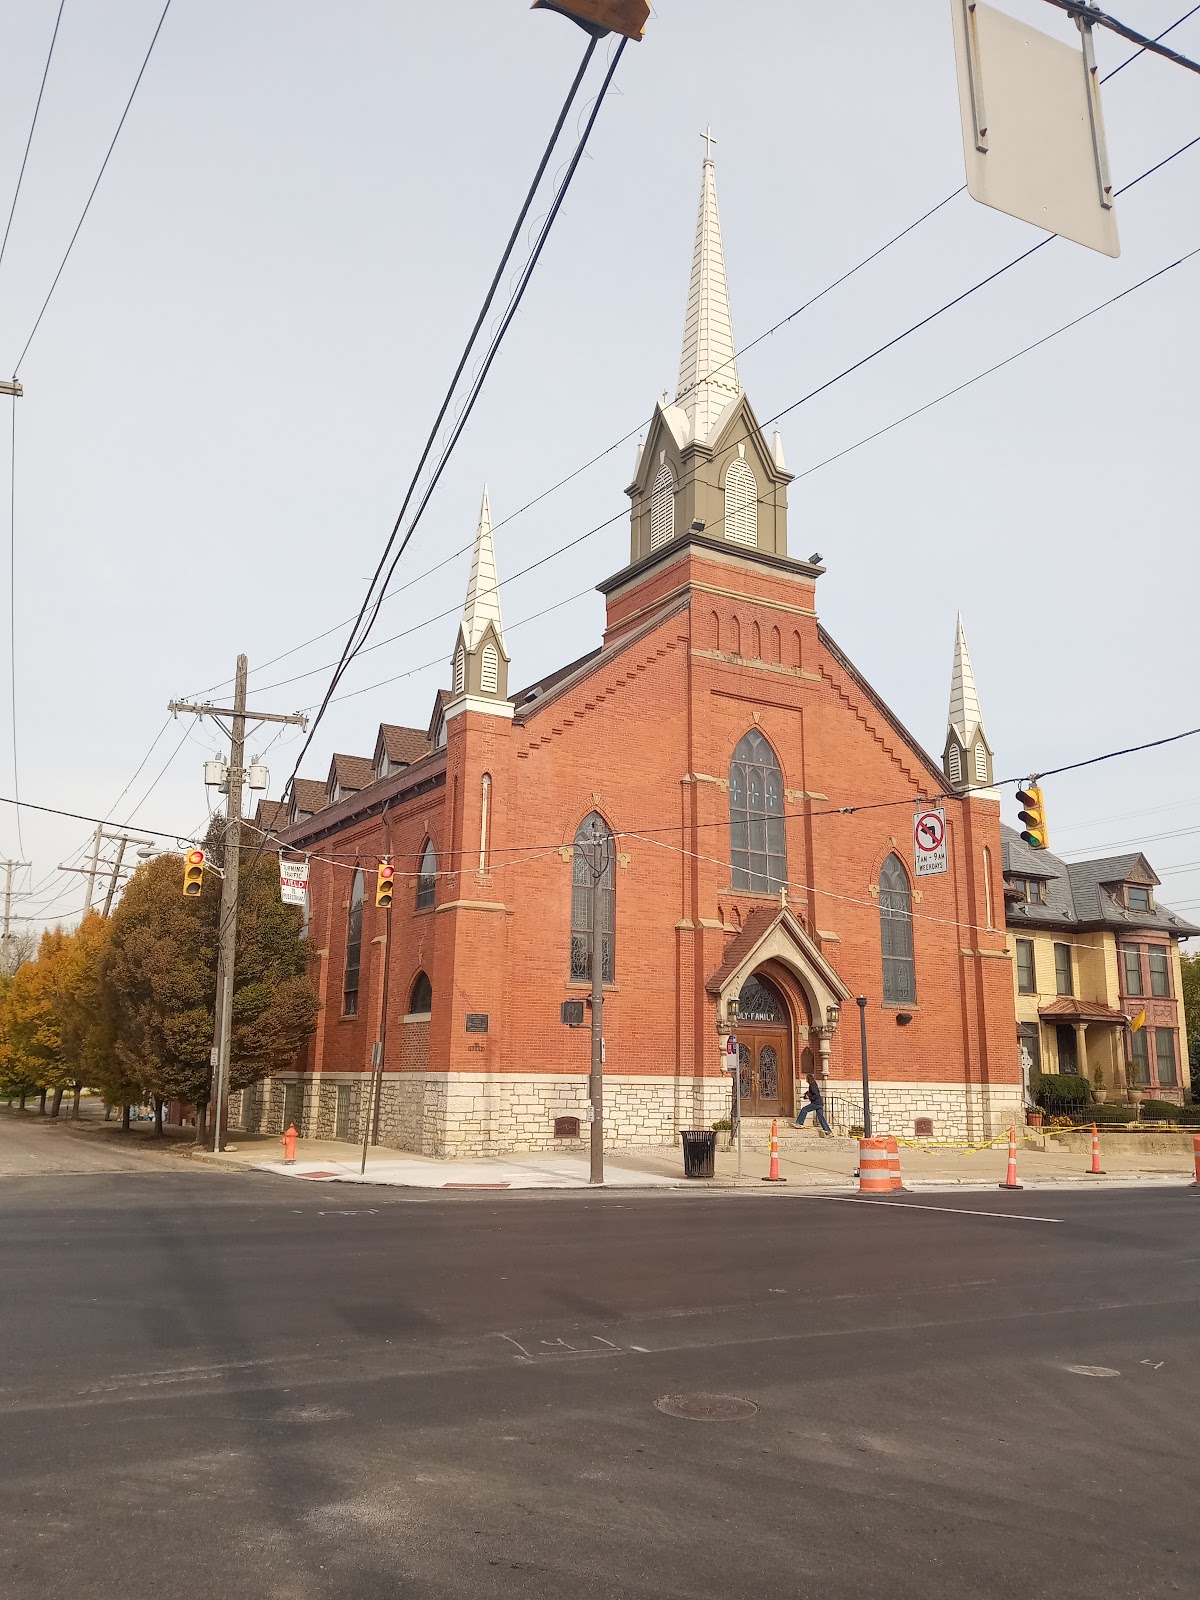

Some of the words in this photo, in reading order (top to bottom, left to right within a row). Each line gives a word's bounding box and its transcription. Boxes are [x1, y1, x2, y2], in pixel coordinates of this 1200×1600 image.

[916, 855, 928, 863] 7AM
[933, 852, 945, 860] 9AM
[283, 865, 304, 873] TURNING
[919, 861, 943, 871] WEEKDAYS
[284, 871, 303, 880] TRAFFIC
[283, 879, 304, 889] YIELD
